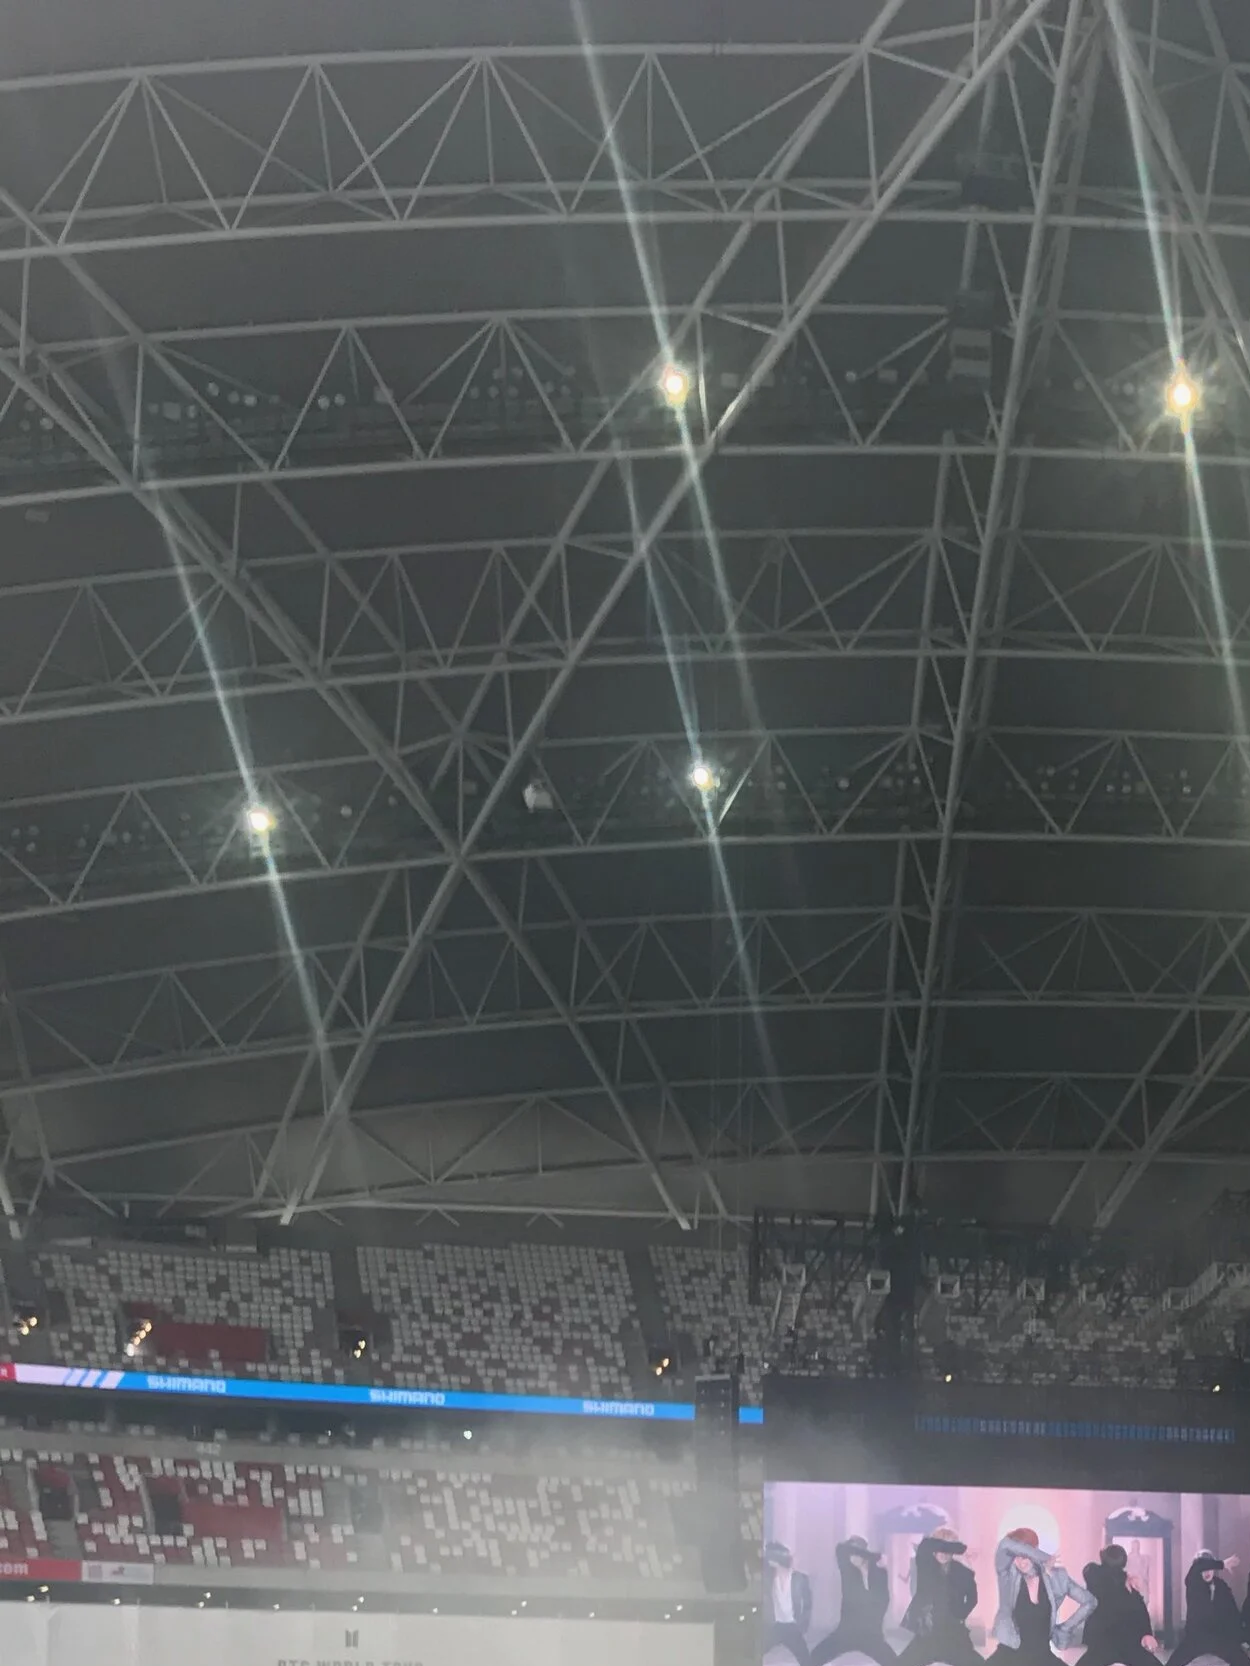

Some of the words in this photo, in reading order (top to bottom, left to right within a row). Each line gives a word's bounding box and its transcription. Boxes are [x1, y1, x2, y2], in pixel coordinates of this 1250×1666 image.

[147, 1375, 227, 1394] SHIMANO
[369, 1388, 446, 1407] SHIMANO
[582, 1400, 655, 1418] SHIMANO
